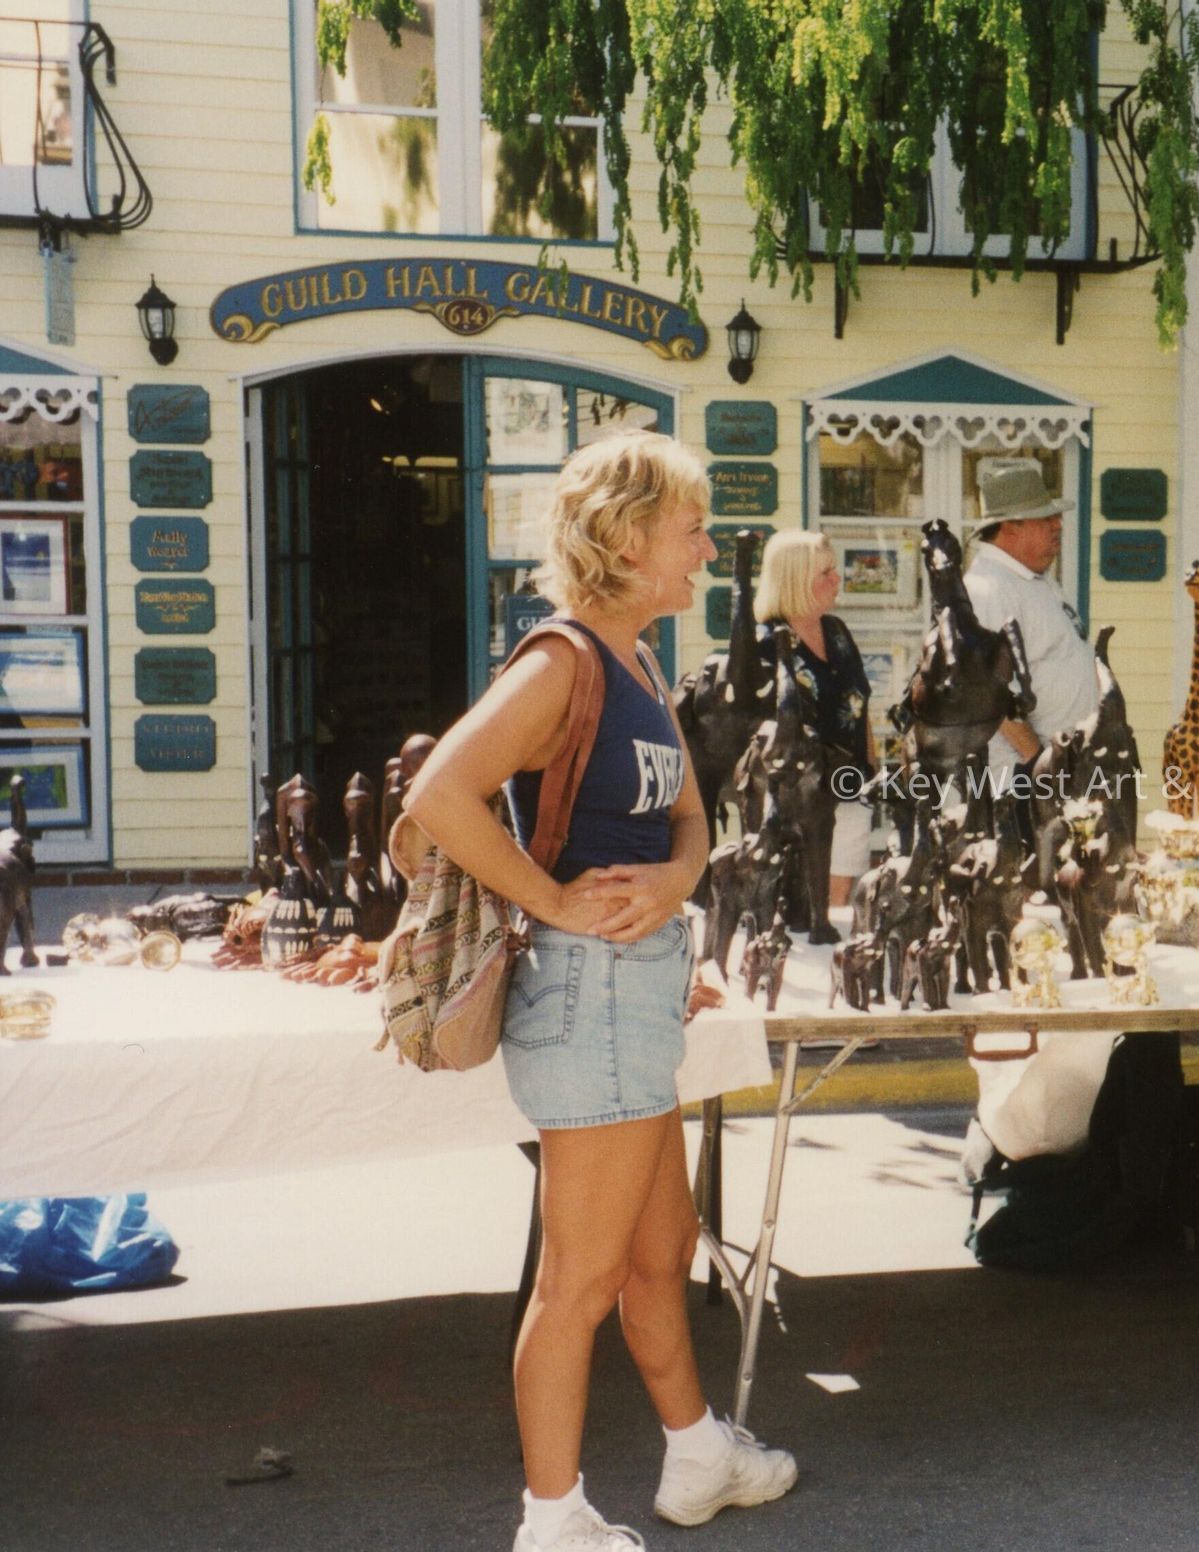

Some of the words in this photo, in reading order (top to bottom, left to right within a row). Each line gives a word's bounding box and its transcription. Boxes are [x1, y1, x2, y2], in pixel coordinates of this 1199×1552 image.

[260, 269, 368, 317] GUILD
[385, 265, 488, 297] HALL
[505, 271, 669, 337] GALLERY
[449, 305, 485, 325] 614
